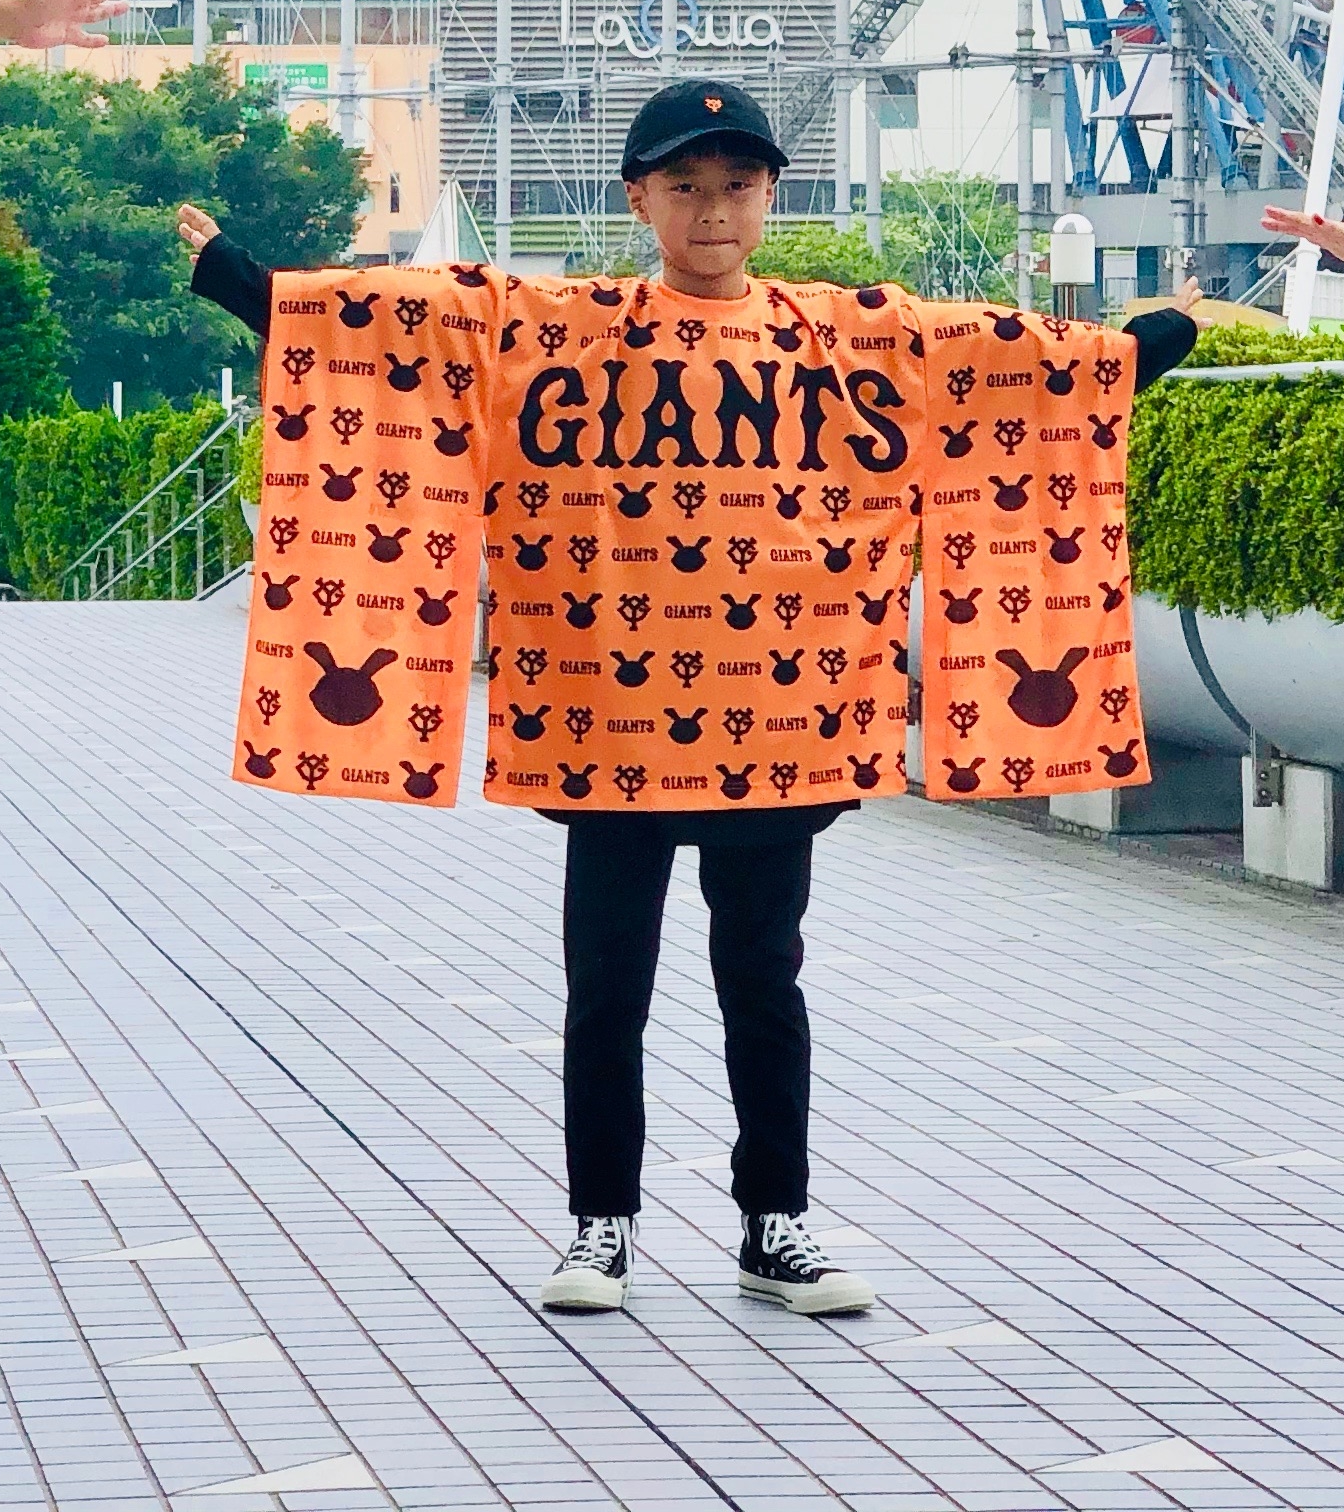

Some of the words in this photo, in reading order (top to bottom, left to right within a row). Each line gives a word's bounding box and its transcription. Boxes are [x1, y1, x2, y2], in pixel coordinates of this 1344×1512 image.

[279, 301, 326, 314] GIANTS
[441, 314, 486, 334] GIANTS
[935, 322, 980, 339] GIANTS
[721, 326, 760, 342] GIANTS
[851, 337, 895, 350] GIANTS
[329, 360, 375, 376] GIANTS
[987, 372, 1033, 387] GIANTS
[518, 359, 907, 472] GIANTS
[376, 423, 422, 439] GIANTS
[1040, 428, 1080, 442] GIANTS
[266, 473, 309, 487] GIANTS
[423, 486, 468, 504] GIANTS
[562, 493, 605, 506] GIANTS
[720, 493, 764, 507] GIANTS
[934, 489, 980, 505] GIANTS
[863, 496, 902, 510] GIANTS
[312, 531, 355, 547] GIANTS
[990, 540, 1036, 554] GIANTS
[612, 548, 658, 562] GIANTS
[770, 549, 812, 562] GIANTS
[357, 594, 404, 610] GIANTS
[511, 602, 554, 616] GIANTS
[1046, 596, 1090, 609] GIANTS
[664, 605, 712, 618] GIANTS
[814, 603, 849, 616] GIANTS
[406, 657, 453, 673] GIANTS
[560, 661, 601, 675] GIANTS
[718, 662, 761, 675] GIANTS
[940, 656, 985, 670] GIANTS
[607, 720, 655, 733] GIANTS
[766, 717, 807, 731] GIANTS
[1045, 760, 1091, 777] GIANTS
[342, 768, 389, 784] GIANTS
[507, 772, 548, 786] GIANTS
[661, 776, 707, 789] GIANTS
